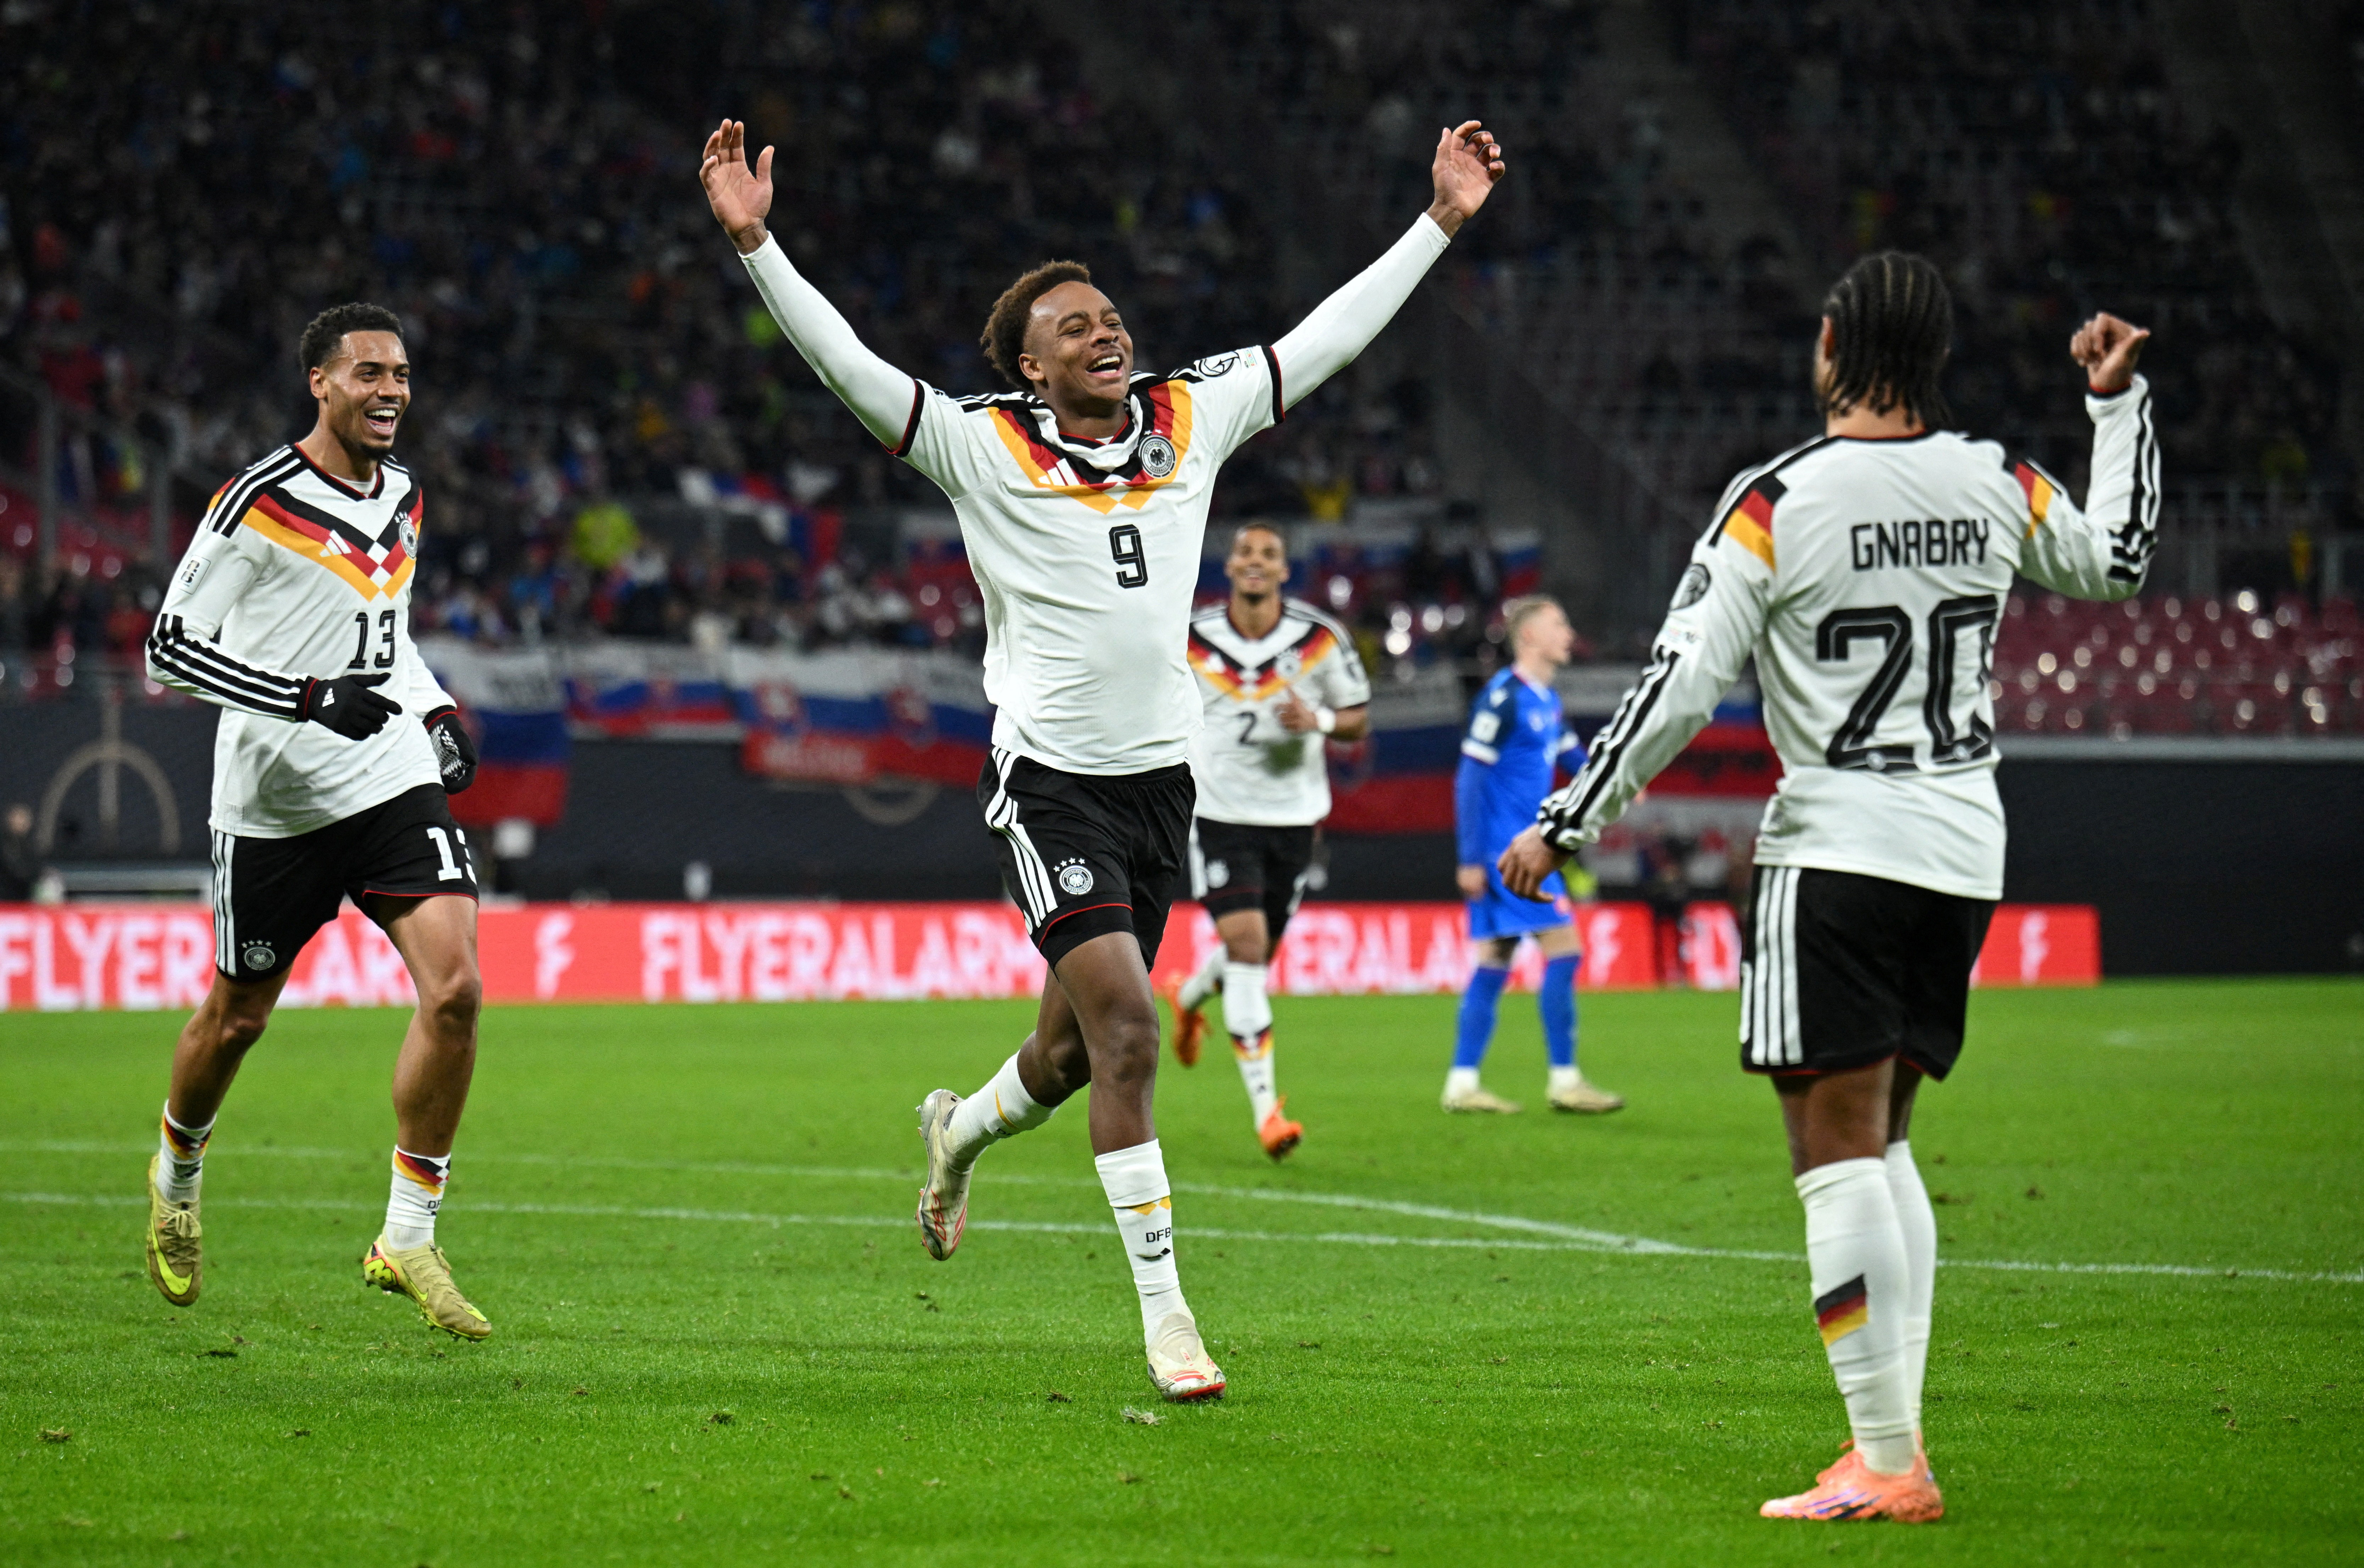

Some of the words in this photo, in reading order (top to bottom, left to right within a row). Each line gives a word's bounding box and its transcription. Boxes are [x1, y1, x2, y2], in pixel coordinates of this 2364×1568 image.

[1145, 442, 1162, 454] DEUTSCHER
[1109, 524, 1148, 589] 9
[1851, 519, 1989, 571] GNABRY
[347, 610, 396, 670] 13
[1816, 594, 1998, 772] 20
[1239, 711, 1261, 745] 2
[641, 911, 1048, 1002] FLYERALARM
[1146, 1227, 1171, 1242] DFB
